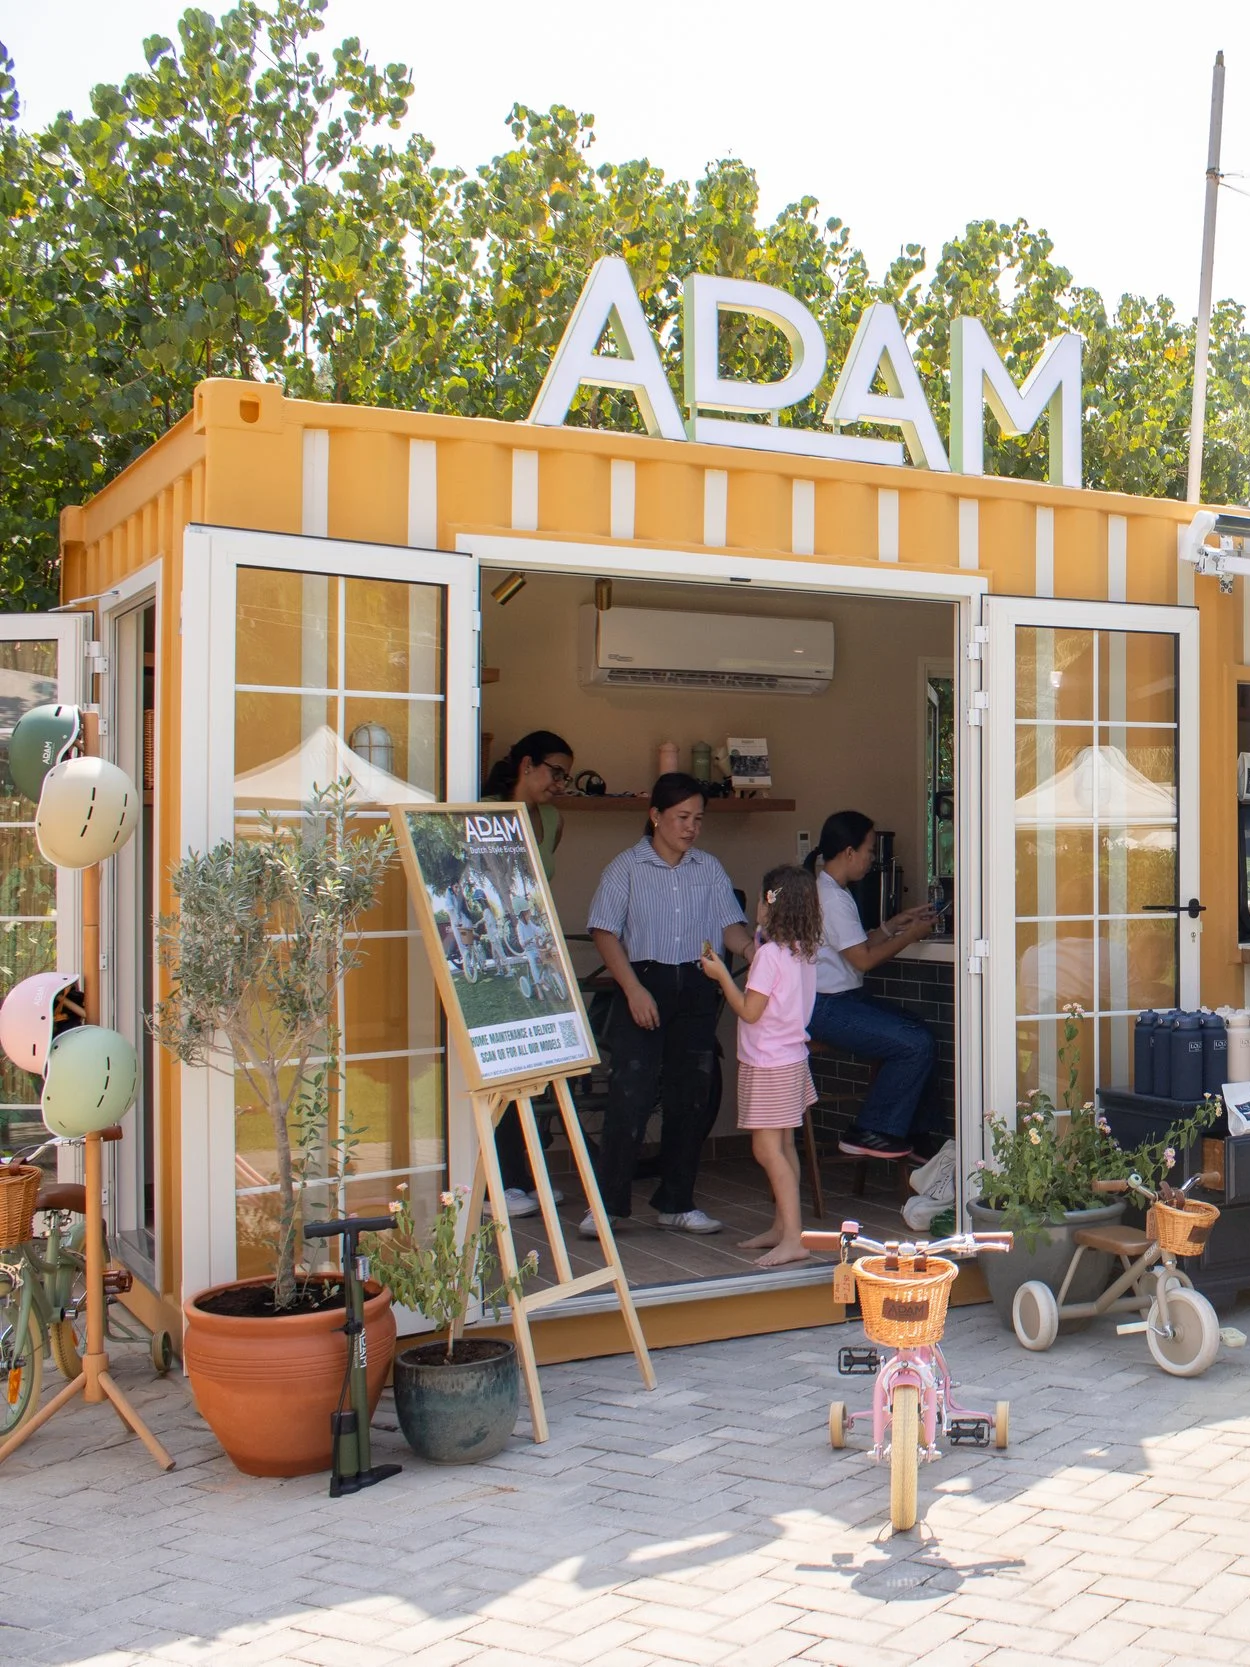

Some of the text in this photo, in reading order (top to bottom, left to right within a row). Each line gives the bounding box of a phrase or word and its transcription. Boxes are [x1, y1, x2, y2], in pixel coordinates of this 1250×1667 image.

[529, 255, 1082, 489] ADAM
[42, 741, 53, 765] ADAM
[464, 816, 523, 843] ADAM
[471, 1022, 557, 1048] HOME MAINTENANCE & DELIVERY
[480, 1038, 561, 1063] SCAN QR FOR ALL OUR MODELS
[888, 1304, 924, 1317] ADAM
